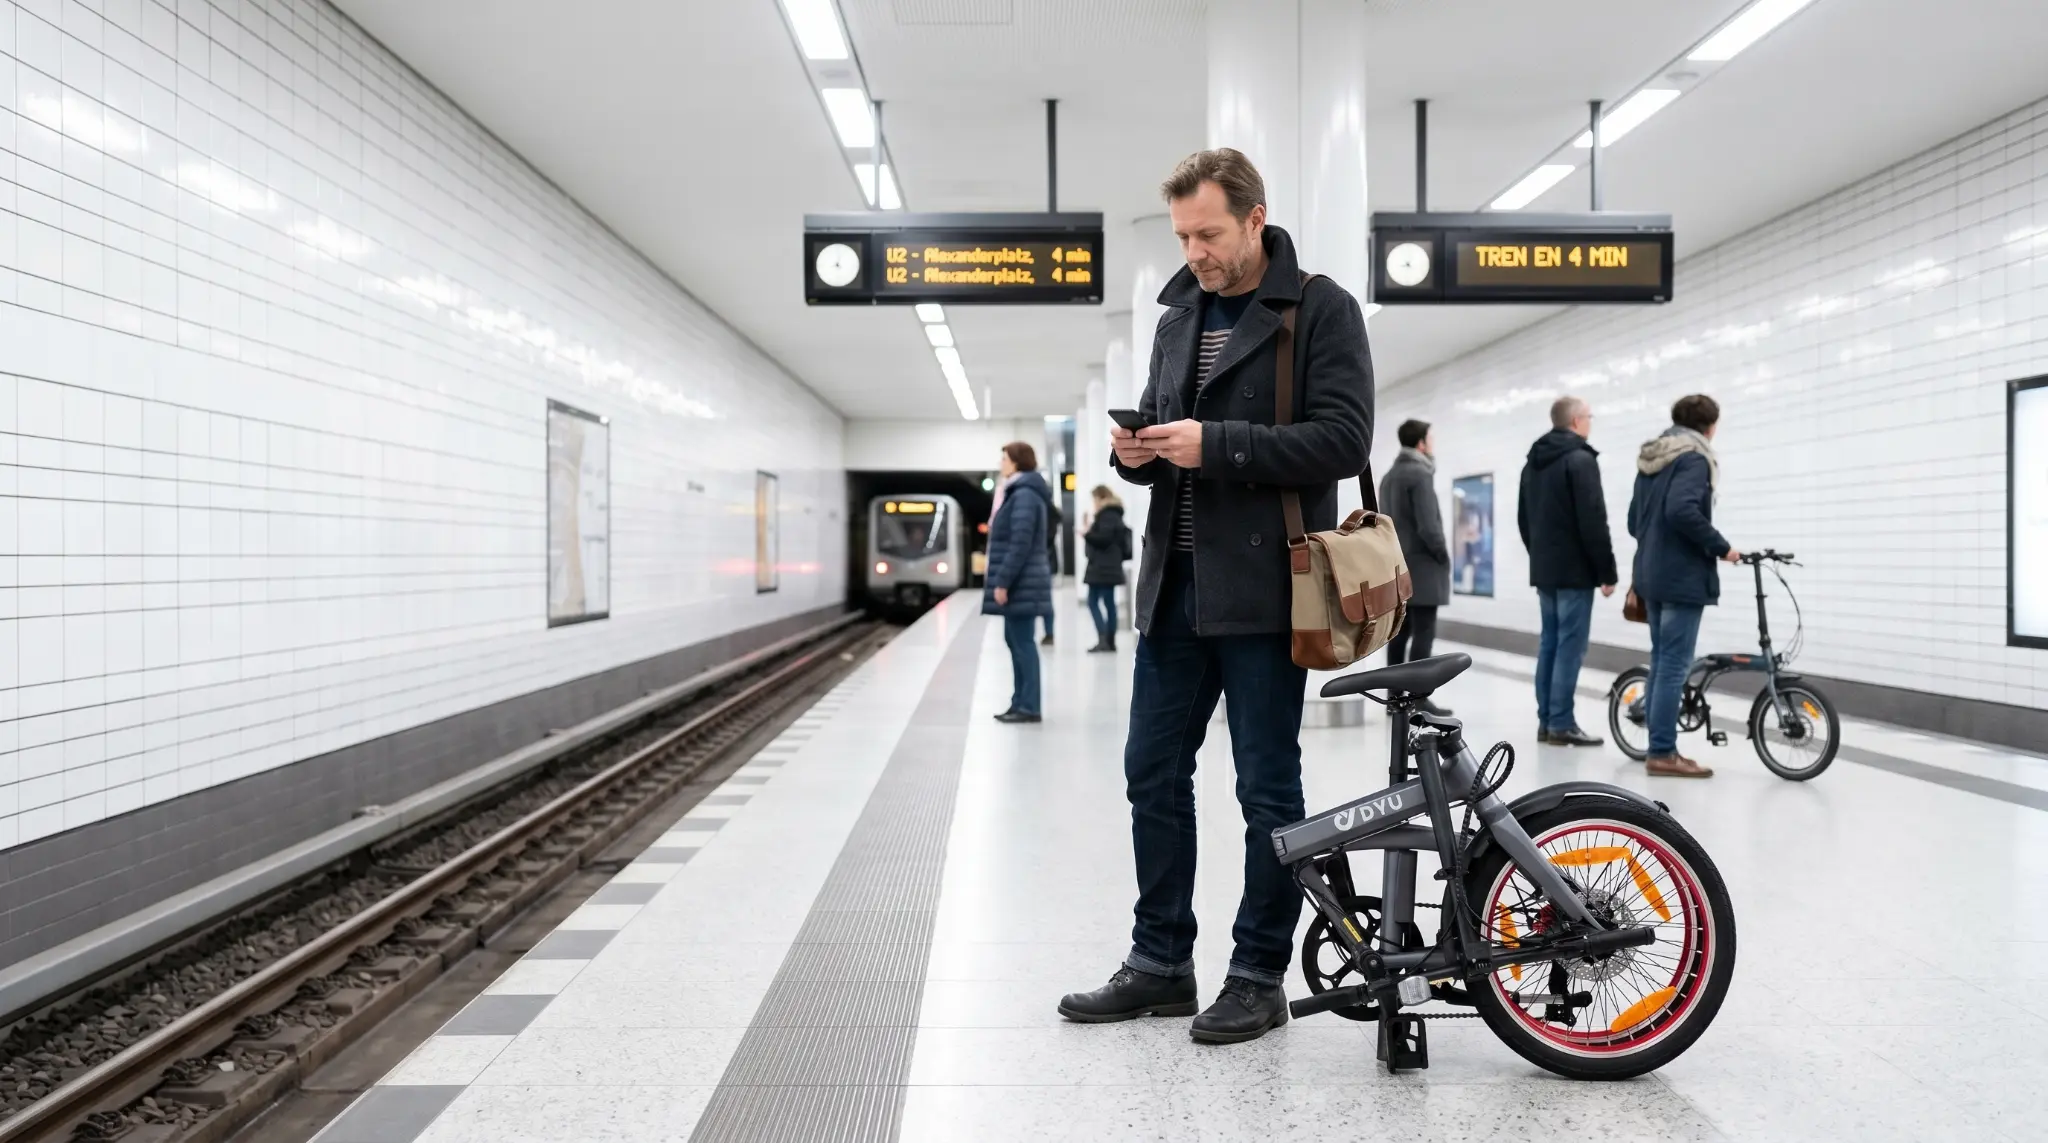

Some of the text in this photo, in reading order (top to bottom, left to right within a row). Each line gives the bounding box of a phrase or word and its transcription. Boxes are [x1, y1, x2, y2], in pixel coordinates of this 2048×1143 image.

[886, 247, 908, 263] U2
[1051, 247, 1063, 263] 4
[1065, 248, 1091, 263] min
[1475, 246, 1628, 267] TREN EN 4 MIN
[886, 267, 908, 283] U2
[1051, 267, 1063, 283] 4
[1065, 268, 1091, 283] min
[1359, 794, 1403, 822] DYU
